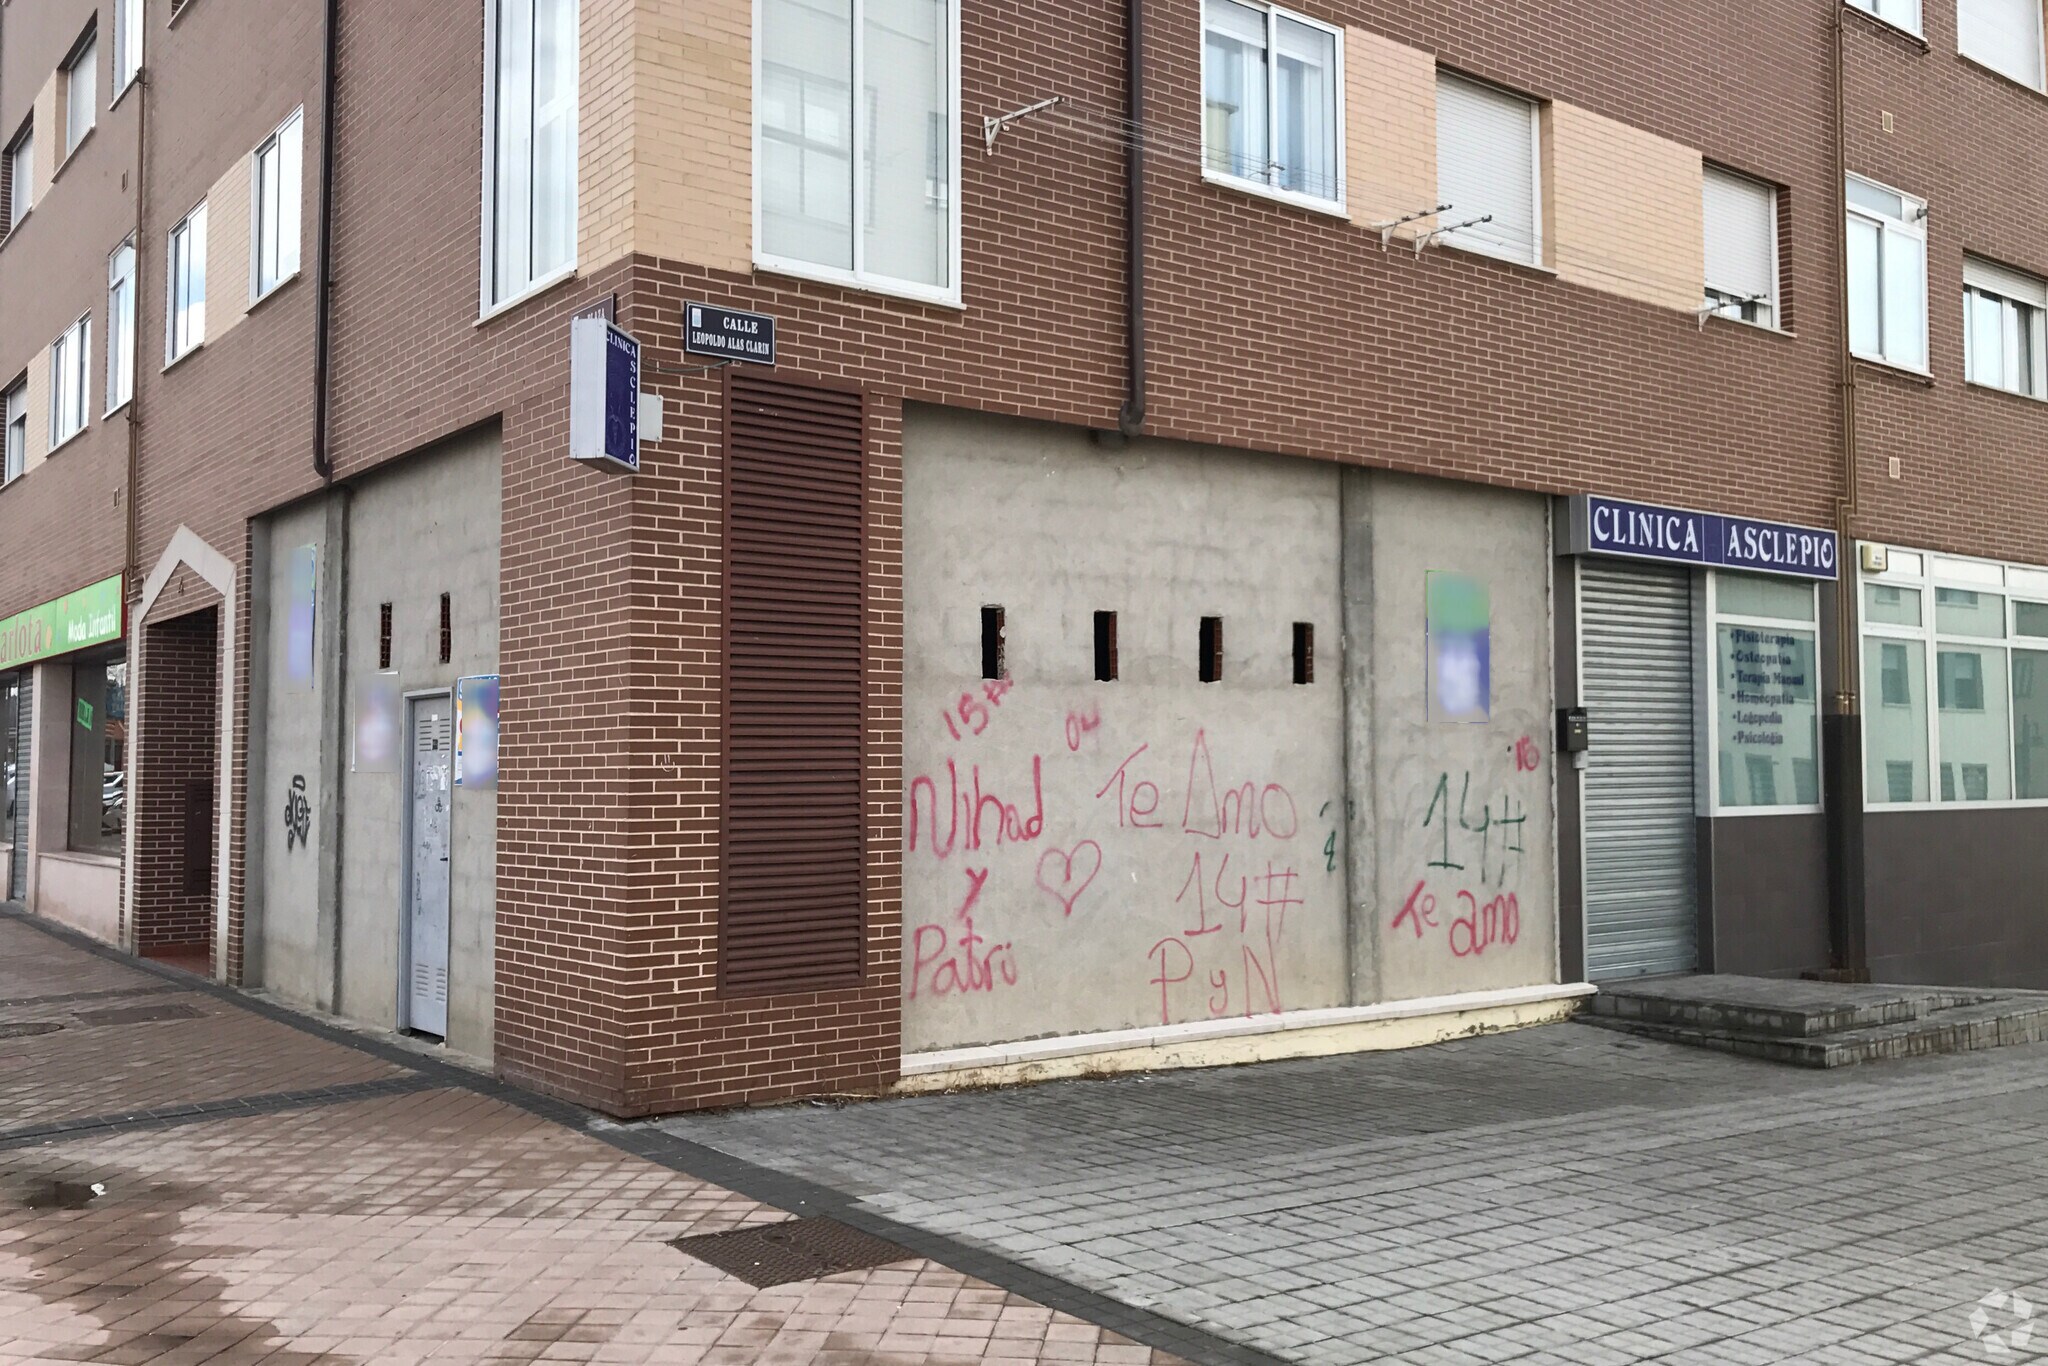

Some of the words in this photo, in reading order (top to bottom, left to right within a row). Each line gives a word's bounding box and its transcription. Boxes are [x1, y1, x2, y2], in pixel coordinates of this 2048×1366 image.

[723, 316, 758, 334] CALLE
[692, 331, 726, 348] LEOPOLDO
[727, 337, 745, 351] ALAS
[745, 340, 770, 355] CLARIN
[1593, 505, 1699, 553] CLINICA
[1727, 524, 1834, 569] ASCLEPIO
[67, 614, 87, 644] Moda
[1737, 669, 1771, 687] Terapia
[1096, 742, 1163, 828] Te
